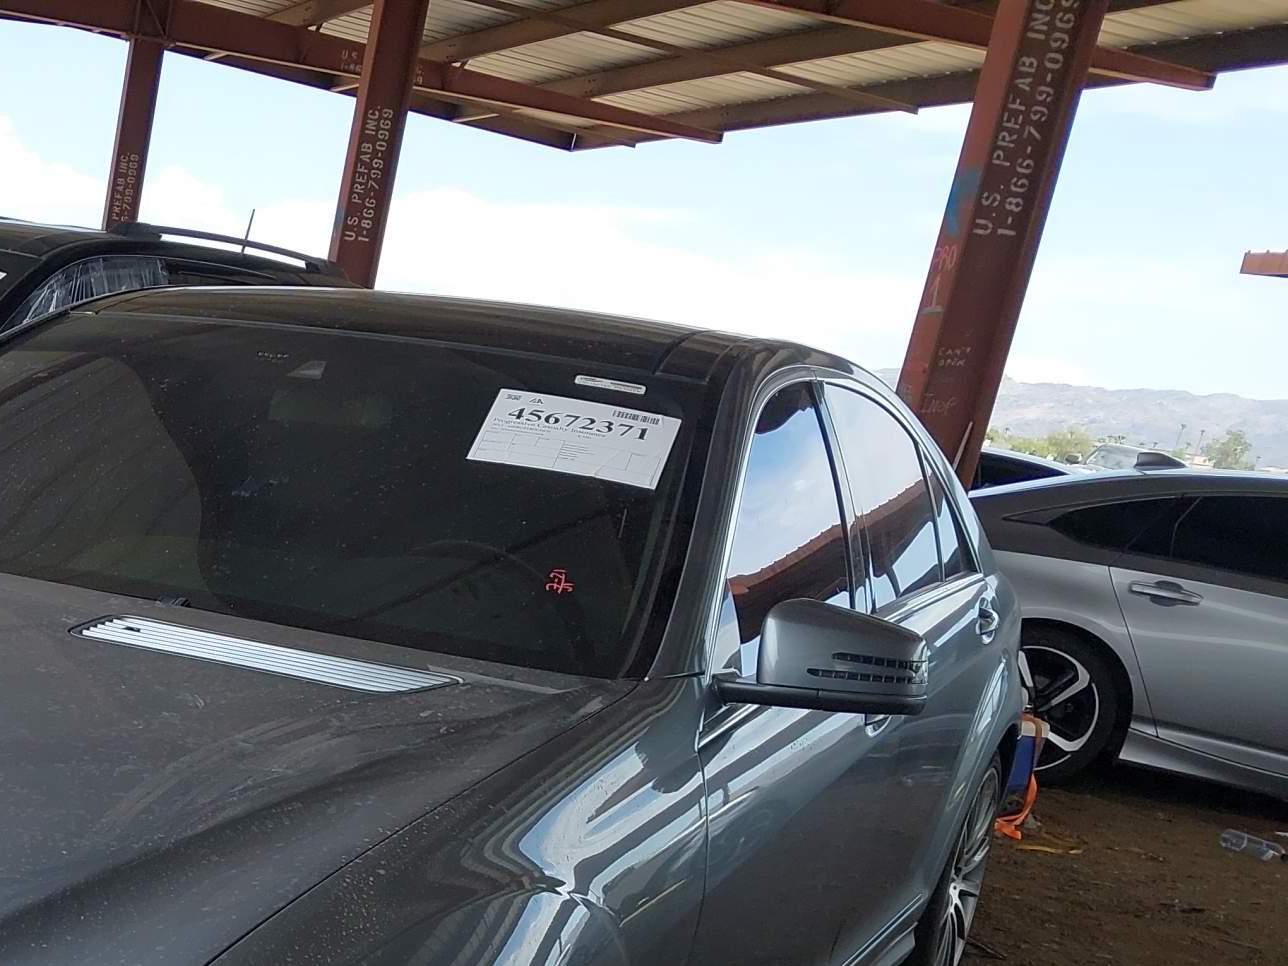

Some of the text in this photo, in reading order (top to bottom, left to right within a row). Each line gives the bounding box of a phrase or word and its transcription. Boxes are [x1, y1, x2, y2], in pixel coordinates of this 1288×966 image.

[351, 143, 373, 203] PREFAB
[365, 105, 381, 136] INC.
[992, 56, 1038, 167] PREFAB
[358, 108, 394, 242] 1-866-799-0969
[507, 407, 649, 441] 45672371
